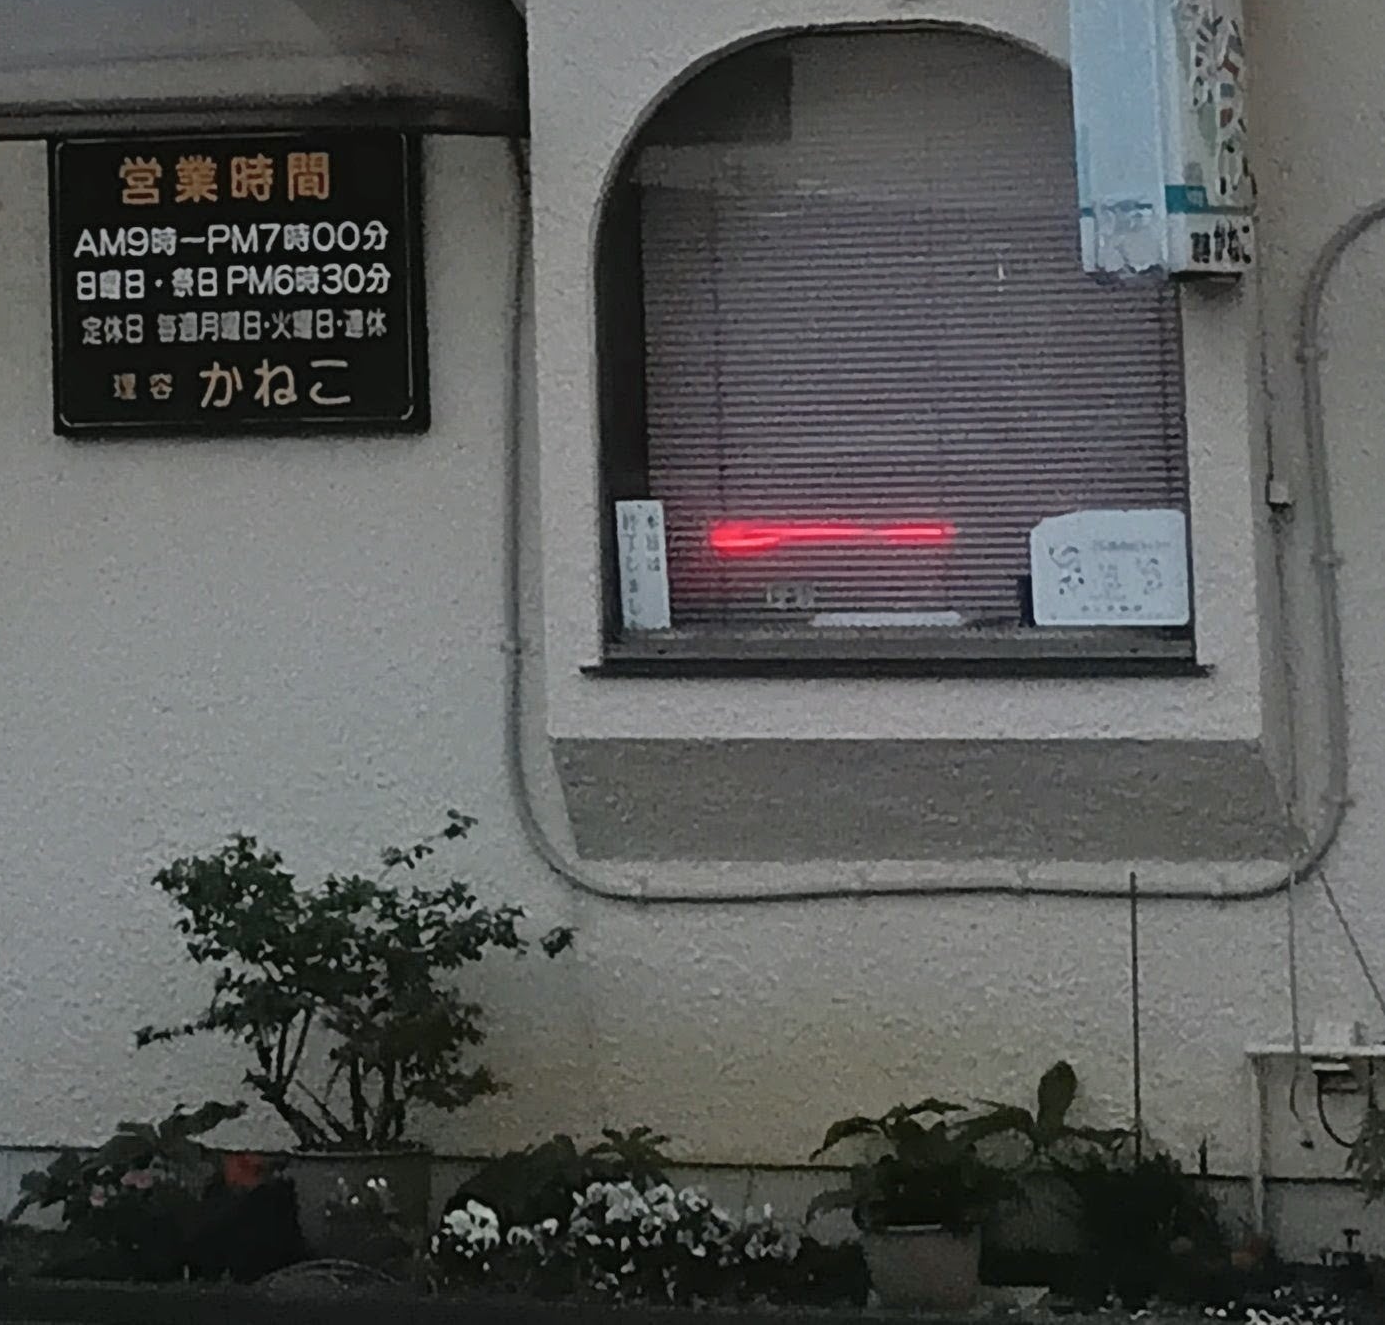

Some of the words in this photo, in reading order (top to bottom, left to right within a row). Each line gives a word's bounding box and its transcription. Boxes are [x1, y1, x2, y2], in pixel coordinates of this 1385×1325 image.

[120, 153, 329, 204] 営業時間
[200, 359, 350, 407] かねこ
